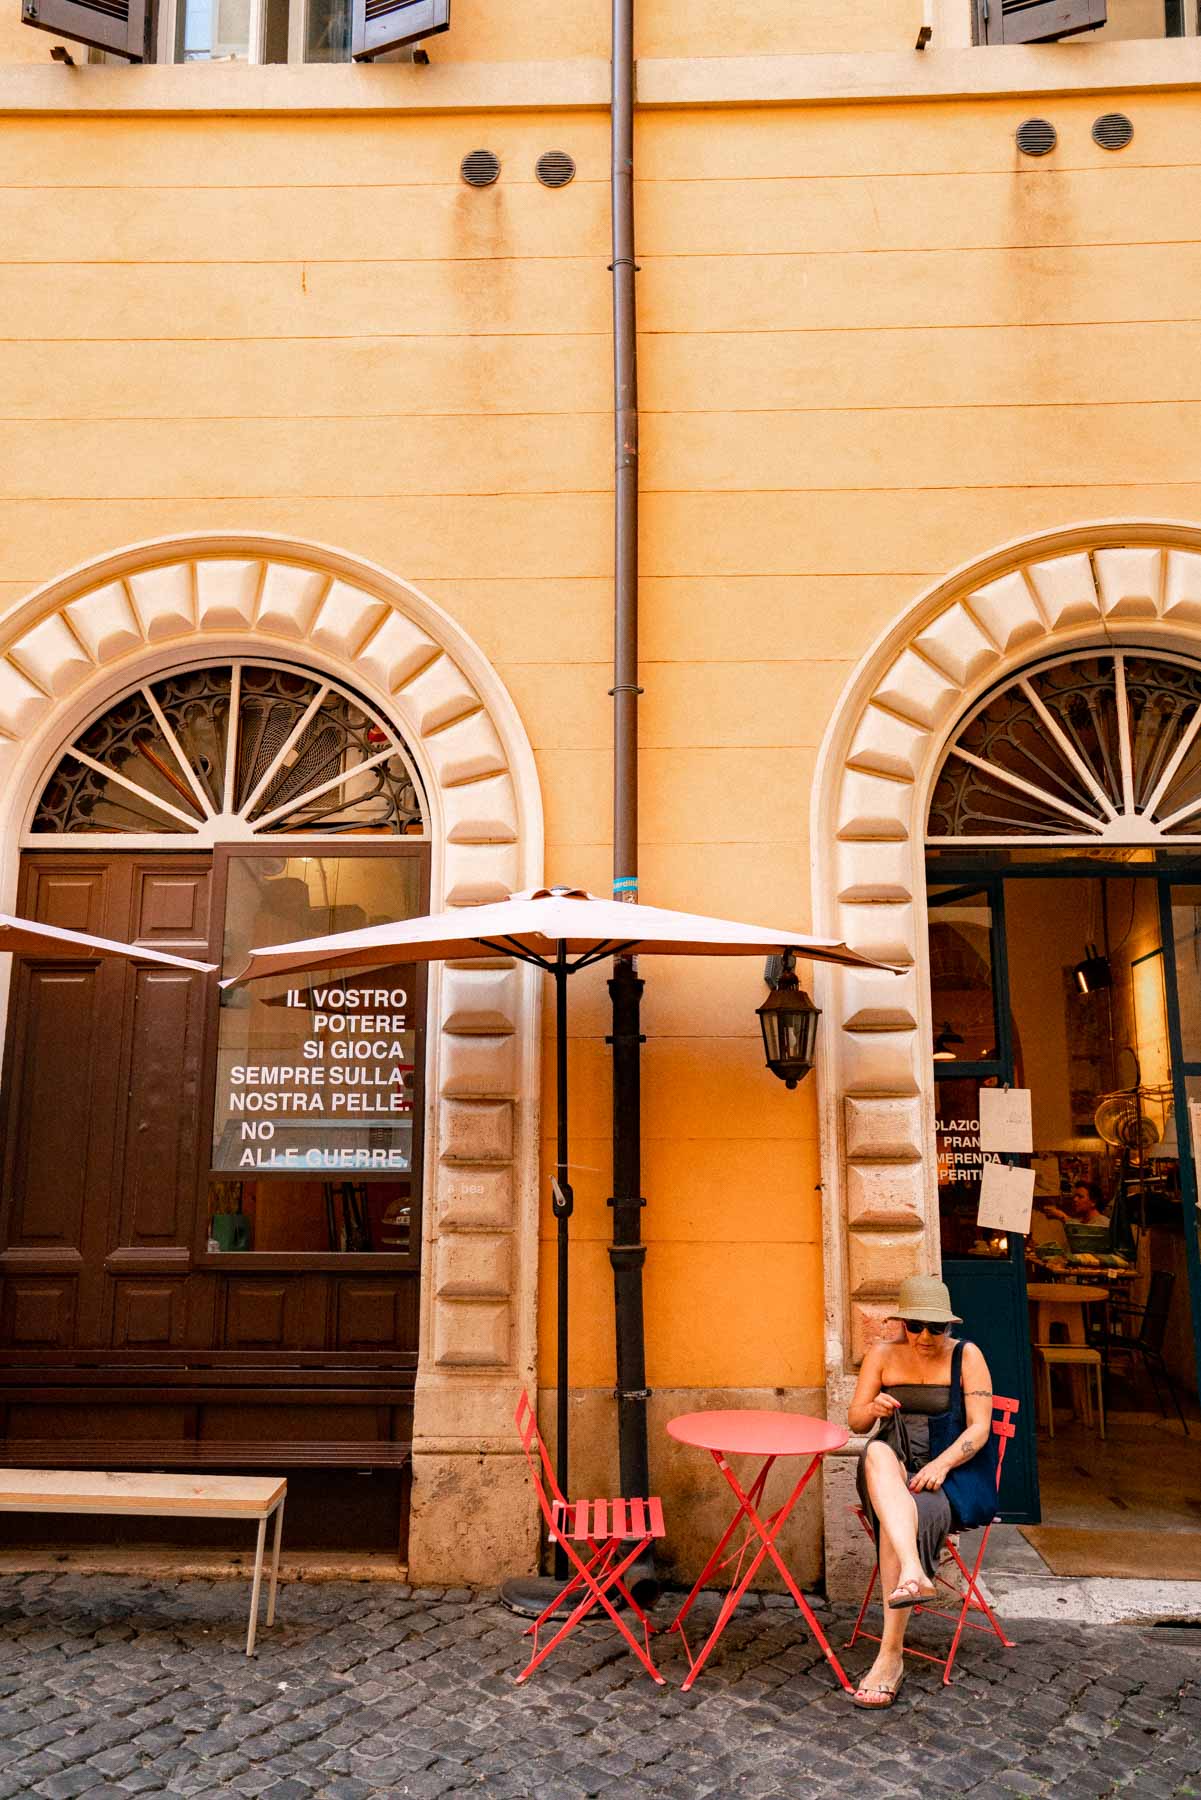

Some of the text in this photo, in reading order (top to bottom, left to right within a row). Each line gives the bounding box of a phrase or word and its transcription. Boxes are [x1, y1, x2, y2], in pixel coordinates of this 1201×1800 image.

[287, 989, 407, 1008] IL VOSTRO
[314, 1014, 406, 1033] POTERE
[303, 1040, 404, 1059] SI GIOCA
[230, 1066, 404, 1085] SEMPRE SULLA
[229, 1092, 410, 1111] NOSTRA PELLE.
[241, 1121, 275, 1140] NO
[239, 1148, 408, 1168] ALLE GUERRE.
[936, 1153, 1001, 1164] MERENDA
